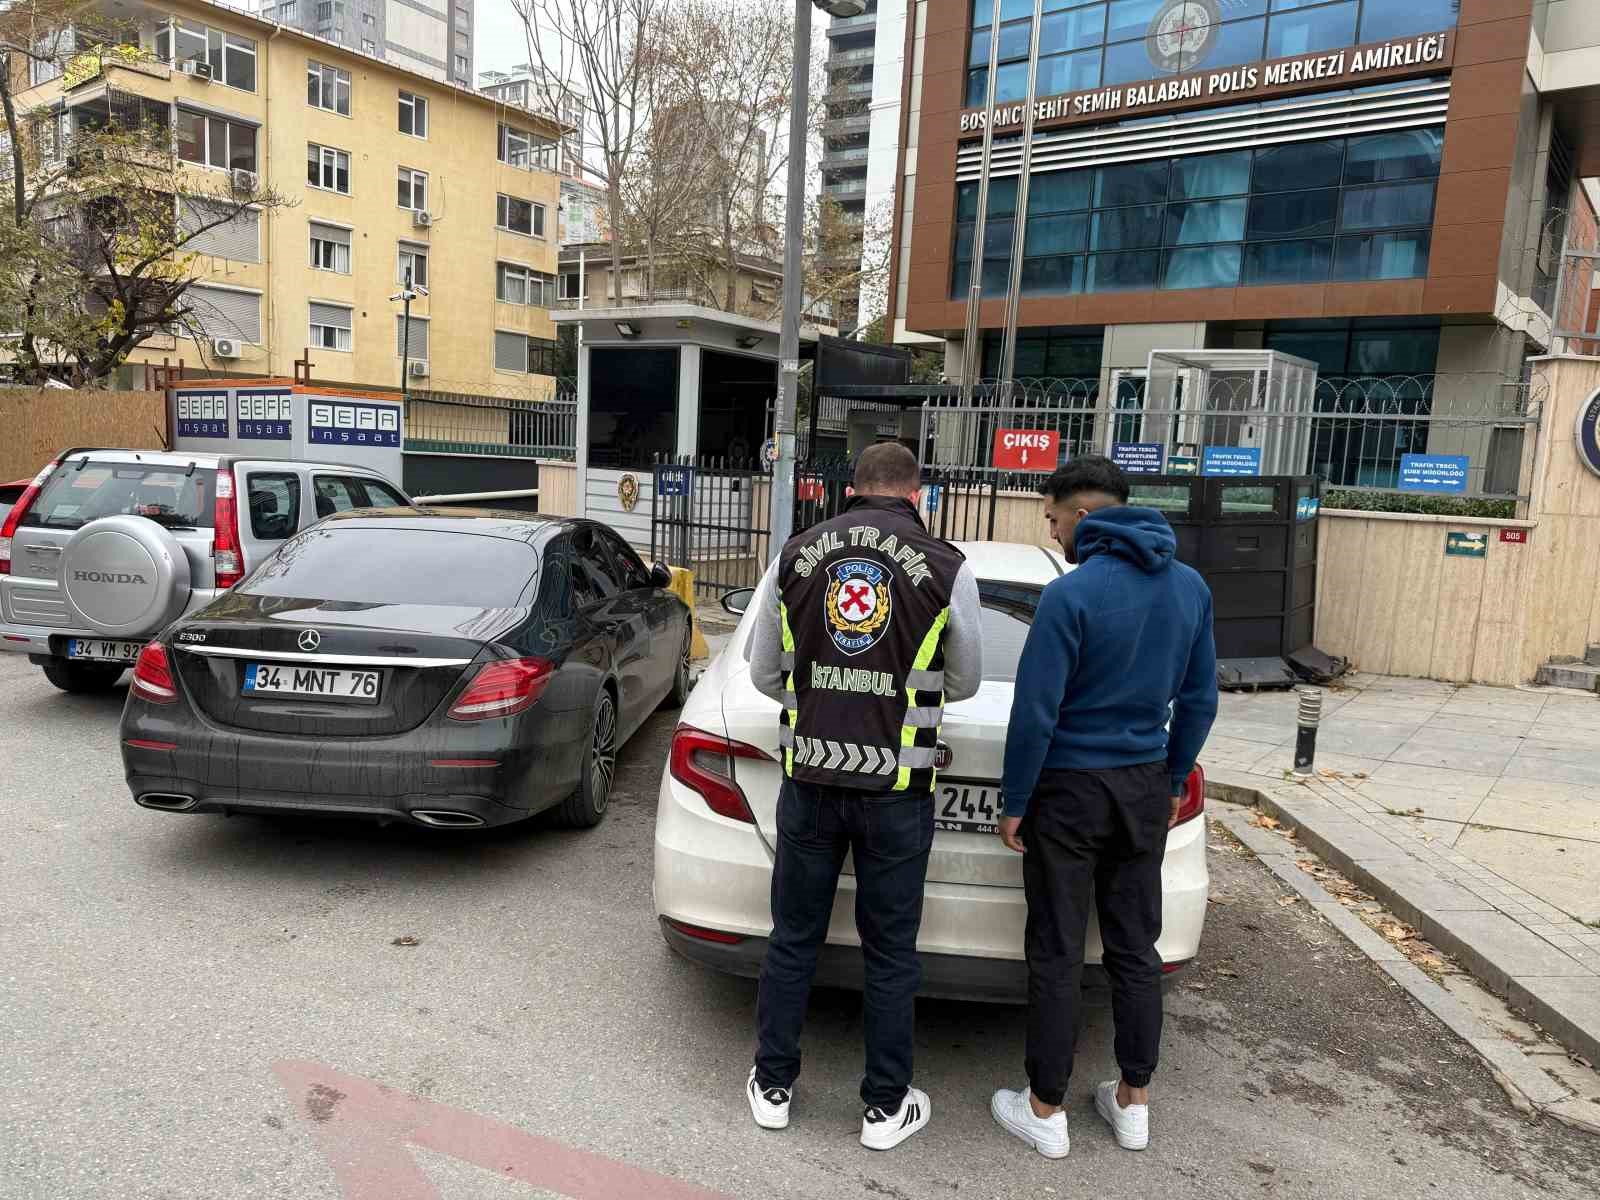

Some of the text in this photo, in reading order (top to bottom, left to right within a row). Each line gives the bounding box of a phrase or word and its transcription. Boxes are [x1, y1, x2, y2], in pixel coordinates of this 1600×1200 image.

[960, 105, 1026, 132] BOSANCI
[1074, 88, 1121, 114] SEMİH
[1126, 77, 1202, 106] BALABAN
[1208, 67, 1258, 96] POLİS
[1264, 51, 1345, 86] MERKEZİ
[1350, 34, 1446, 73] AMİRLİĞİ
[179, 400, 225, 420] SEFA
[239, 399, 291, 420] SEFA
[315, 408, 394, 427] SEFA
[1003, 433, 1050, 452] ÇIKIŞ
[795, 526, 933, 587] SİVİL TRAFİK
[73, 570, 148, 585] HONDA
[845, 563, 875, 575] POLİS
[76, 641, 92, 655] 34
[123, 644, 147, 658] 92
[257, 667, 281, 689] 34
[293, 670, 340, 693] MNT
[350, 672, 376, 695] 76
[811, 660, 897, 697] İSTANBUL
